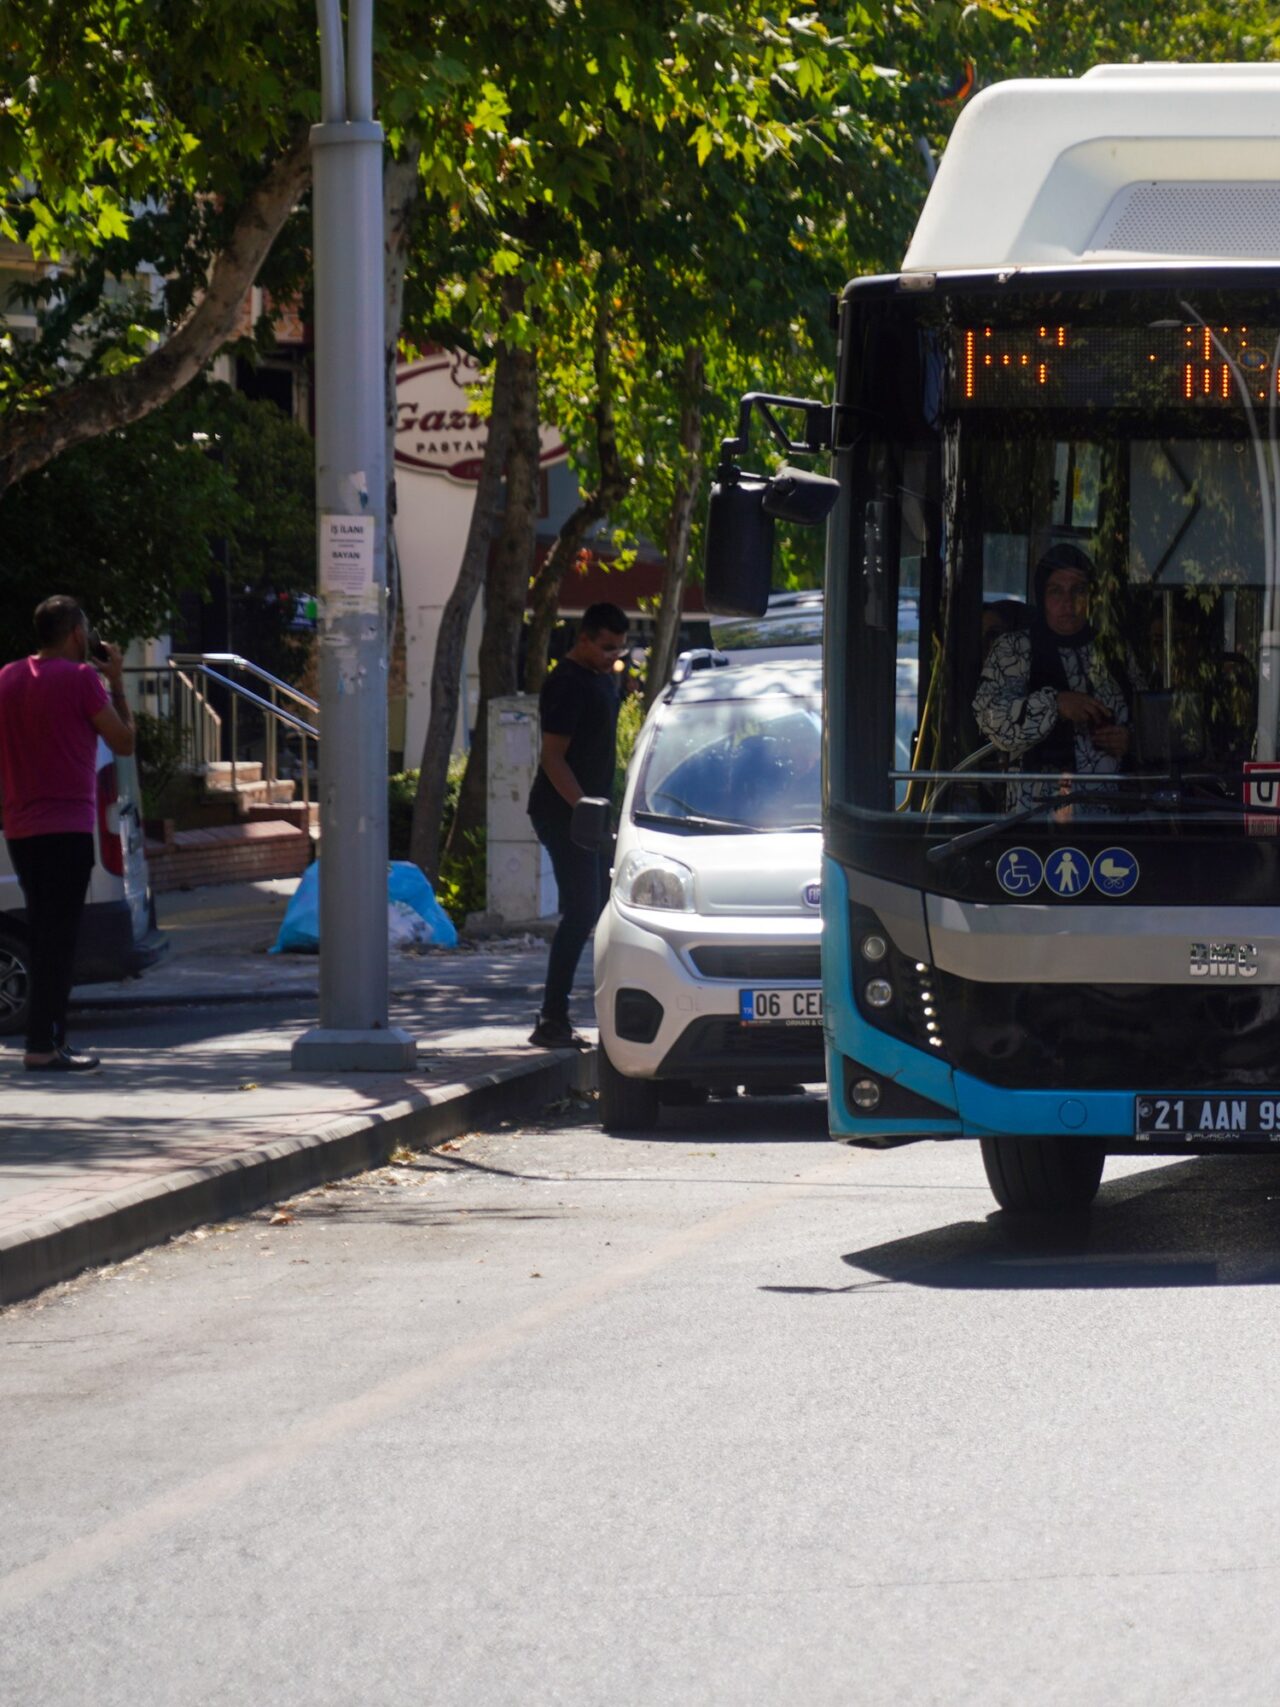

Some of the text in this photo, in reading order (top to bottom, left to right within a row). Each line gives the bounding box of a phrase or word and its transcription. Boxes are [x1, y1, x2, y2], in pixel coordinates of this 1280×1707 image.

[1189, 943, 1258, 977] BMC
[755, 993, 780, 1017] 06
[1155, 1100, 1184, 1130] 21
[1199, 1100, 1247, 1130] AAN
